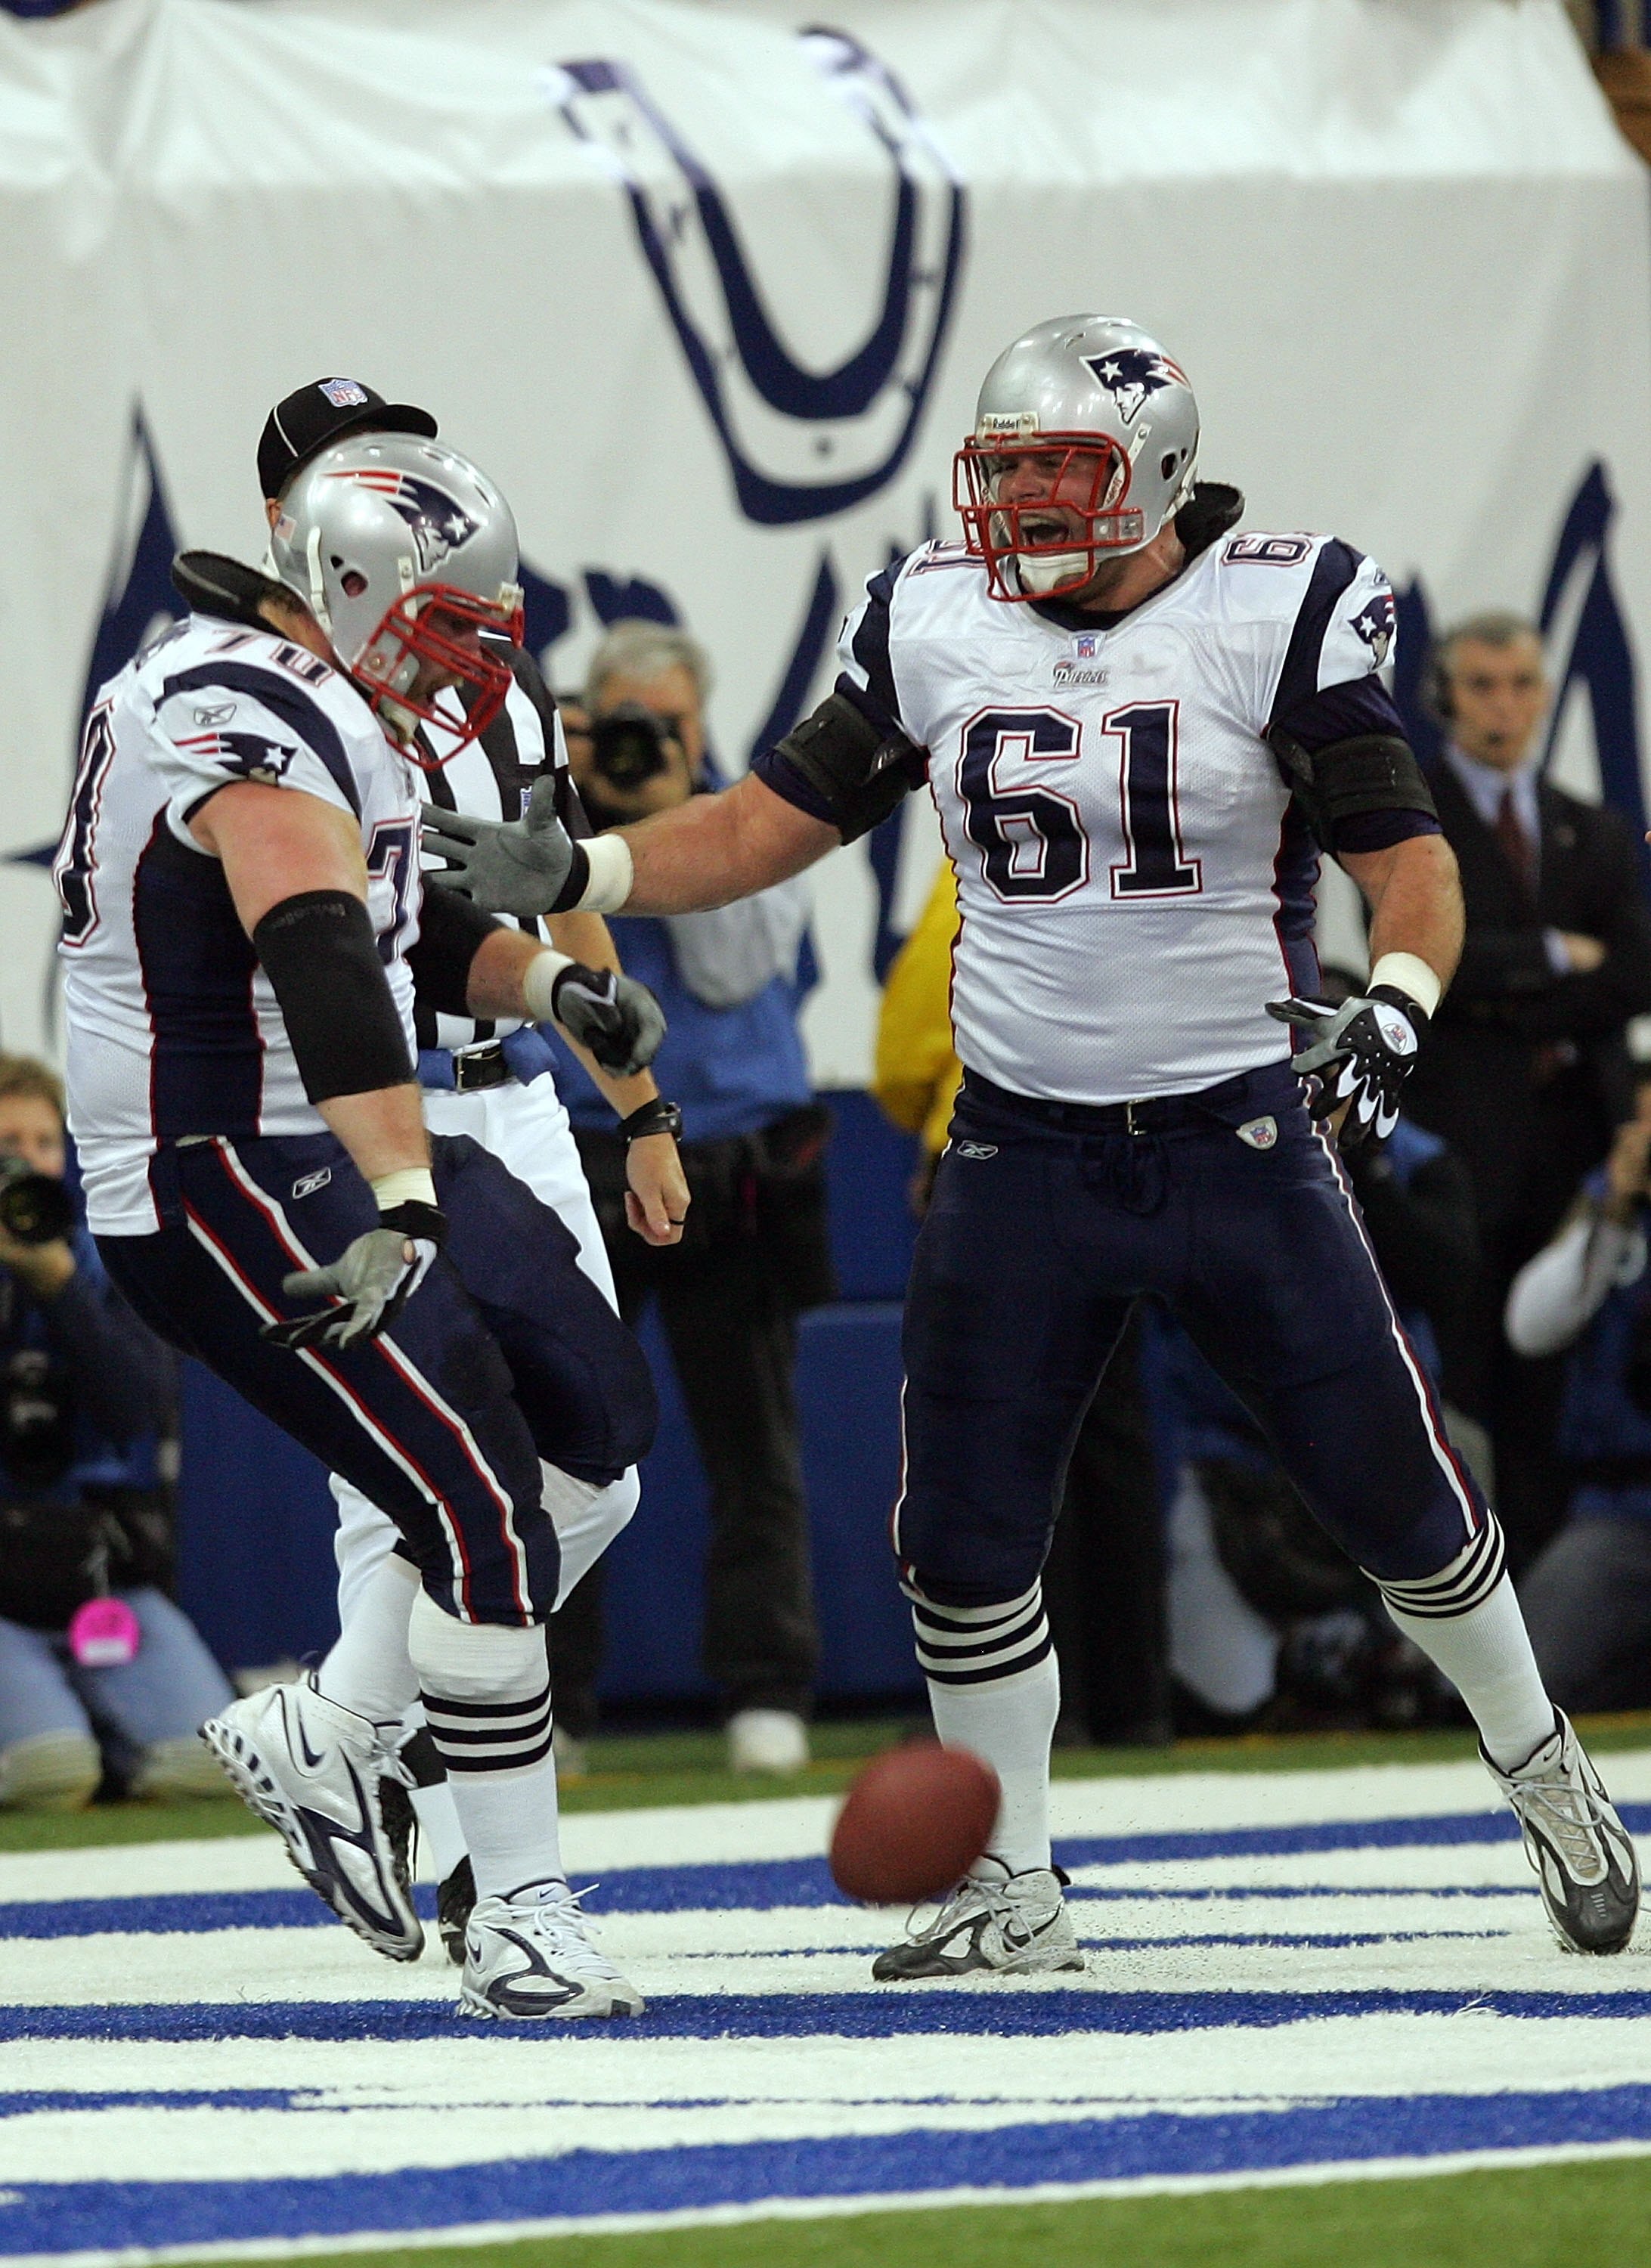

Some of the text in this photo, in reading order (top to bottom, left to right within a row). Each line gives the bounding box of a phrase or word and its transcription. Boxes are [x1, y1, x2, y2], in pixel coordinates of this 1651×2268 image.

[332, 388, 364, 403] NFL
[1221, 531, 1313, 567] 6
[955, 699, 1203, 905] 61
